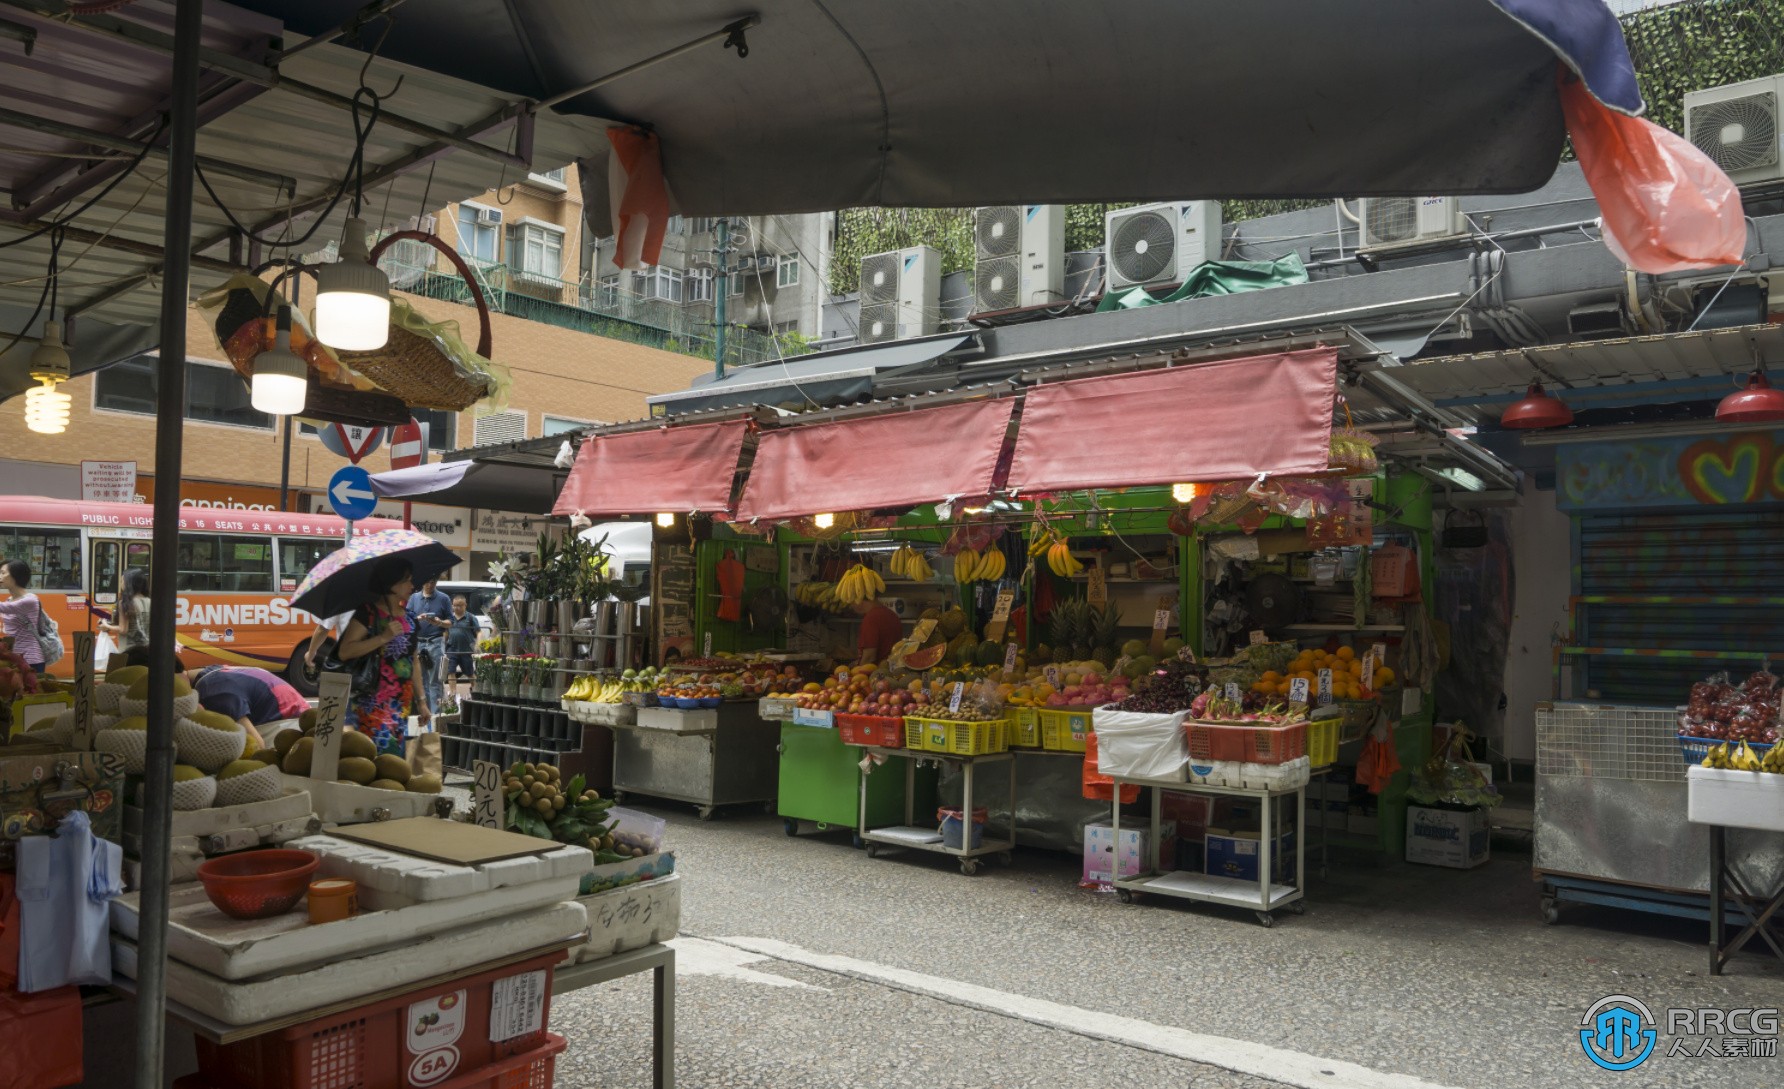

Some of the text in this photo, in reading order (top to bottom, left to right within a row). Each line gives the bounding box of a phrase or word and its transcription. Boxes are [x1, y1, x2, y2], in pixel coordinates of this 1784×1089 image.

[82, 514, 154, 526] PUBLIC LIGH
[195, 520, 205, 528] 16
[215, 520, 244, 530] SEATS
[421, 1055, 448, 1076] 5A
